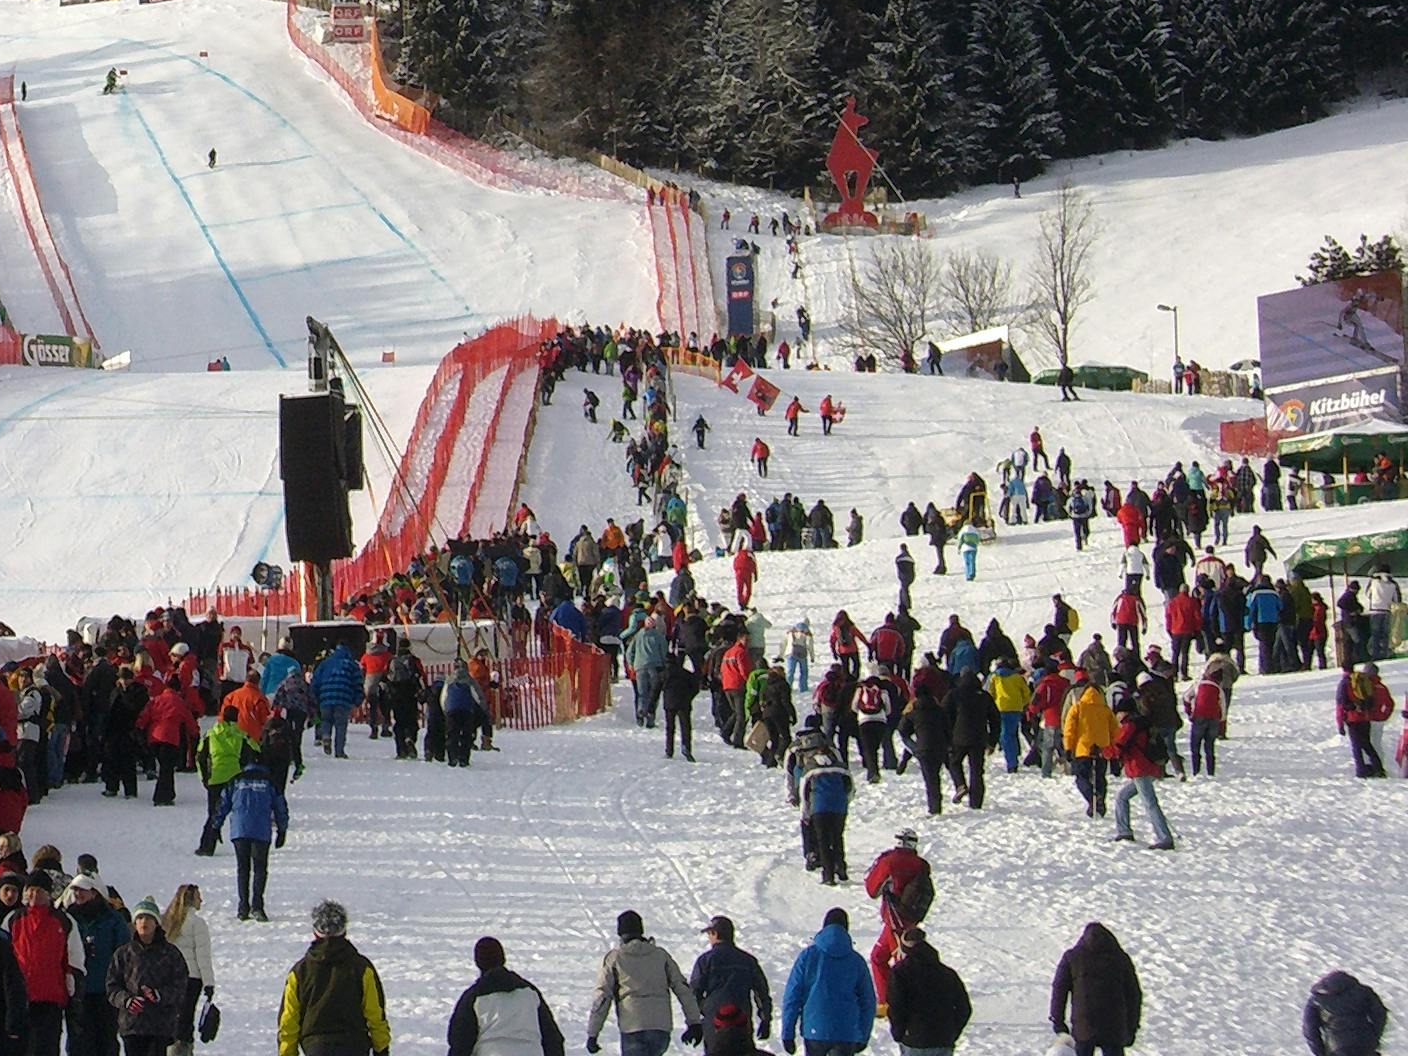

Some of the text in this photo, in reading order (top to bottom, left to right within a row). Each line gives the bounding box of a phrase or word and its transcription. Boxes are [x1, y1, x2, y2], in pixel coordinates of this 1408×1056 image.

[334, 8, 361, 18] ORF
[335, 26, 362, 36] ORF
[1310, 389, 1386, 415] Kitzbühel
